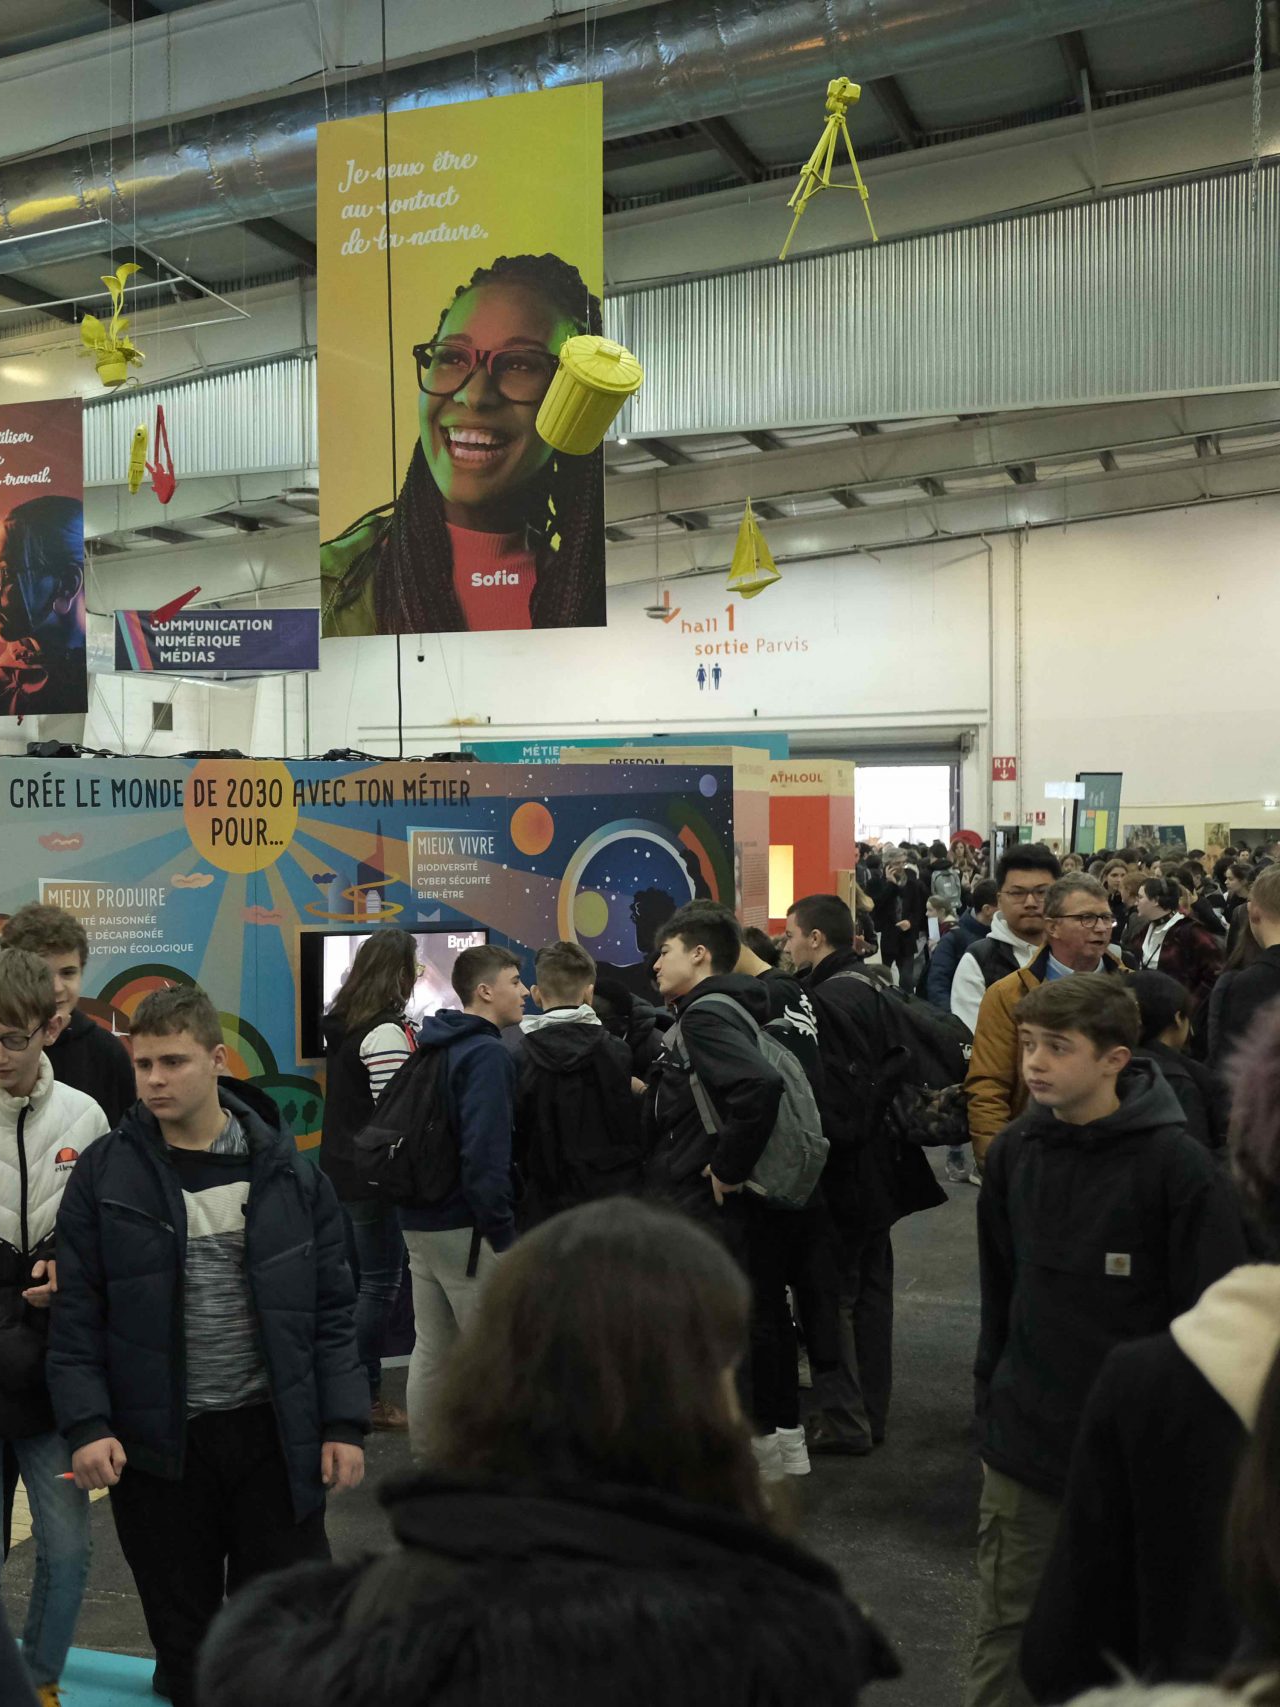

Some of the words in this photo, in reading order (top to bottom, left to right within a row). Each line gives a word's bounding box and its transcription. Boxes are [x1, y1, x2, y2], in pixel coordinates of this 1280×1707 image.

[338, 159, 369, 193] Je
[371, 162, 424, 181] veux
[433, 150, 478, 172] être
[341, 202, 374, 220] au
[376, 185, 460, 216] contact
[341, 228, 370, 256] de
[373, 223, 404, 250] la
[407, 222, 489, 246] nature.
[3, 466, 51, 485] travail.
[471, 569, 519, 587] Sofia
[681, 618, 718, 633] hall
[725, 603, 734, 631] 1
[155, 633, 241, 648] NUMÉRIQUE
[695, 639, 749, 656] sortie
[756, 636, 809, 653] Parvis
[160, 648, 215, 662] MÉDIAS
[523, 743, 576, 756] MÉTIE
[994, 759, 1015, 768] RIA
[10, 771, 66, 808] CRÉE
[76, 779, 101, 807] LE
[111, 778, 184, 808] MONDE
[193, 779, 217, 807] DE
[227, 778, 283, 807] 2030
[293, 779, 346, 807] AVEC
[355, 779, 394, 807] TON
[403, 772, 471, 807] MÉTIER
[417, 837, 455, 855] MIEUX
[459, 836, 495, 855] VIVRE
[417, 860, 478, 872] BIODIVERSITÉ
[417, 877, 446, 885] CYBER
[449, 873, 491, 885] SÉCURITÉ
[48, 889, 91, 908] MIEUX
[97, 887, 166, 908] PRODUIRE
[417, 888, 464, 899] BIEN-ÊTRE
[99, 913, 157, 926] RAISONNÉE
[95, 928, 164, 940] DÉCARBONÉE
[130, 942, 194, 954] ÉCOLOGIQUE
